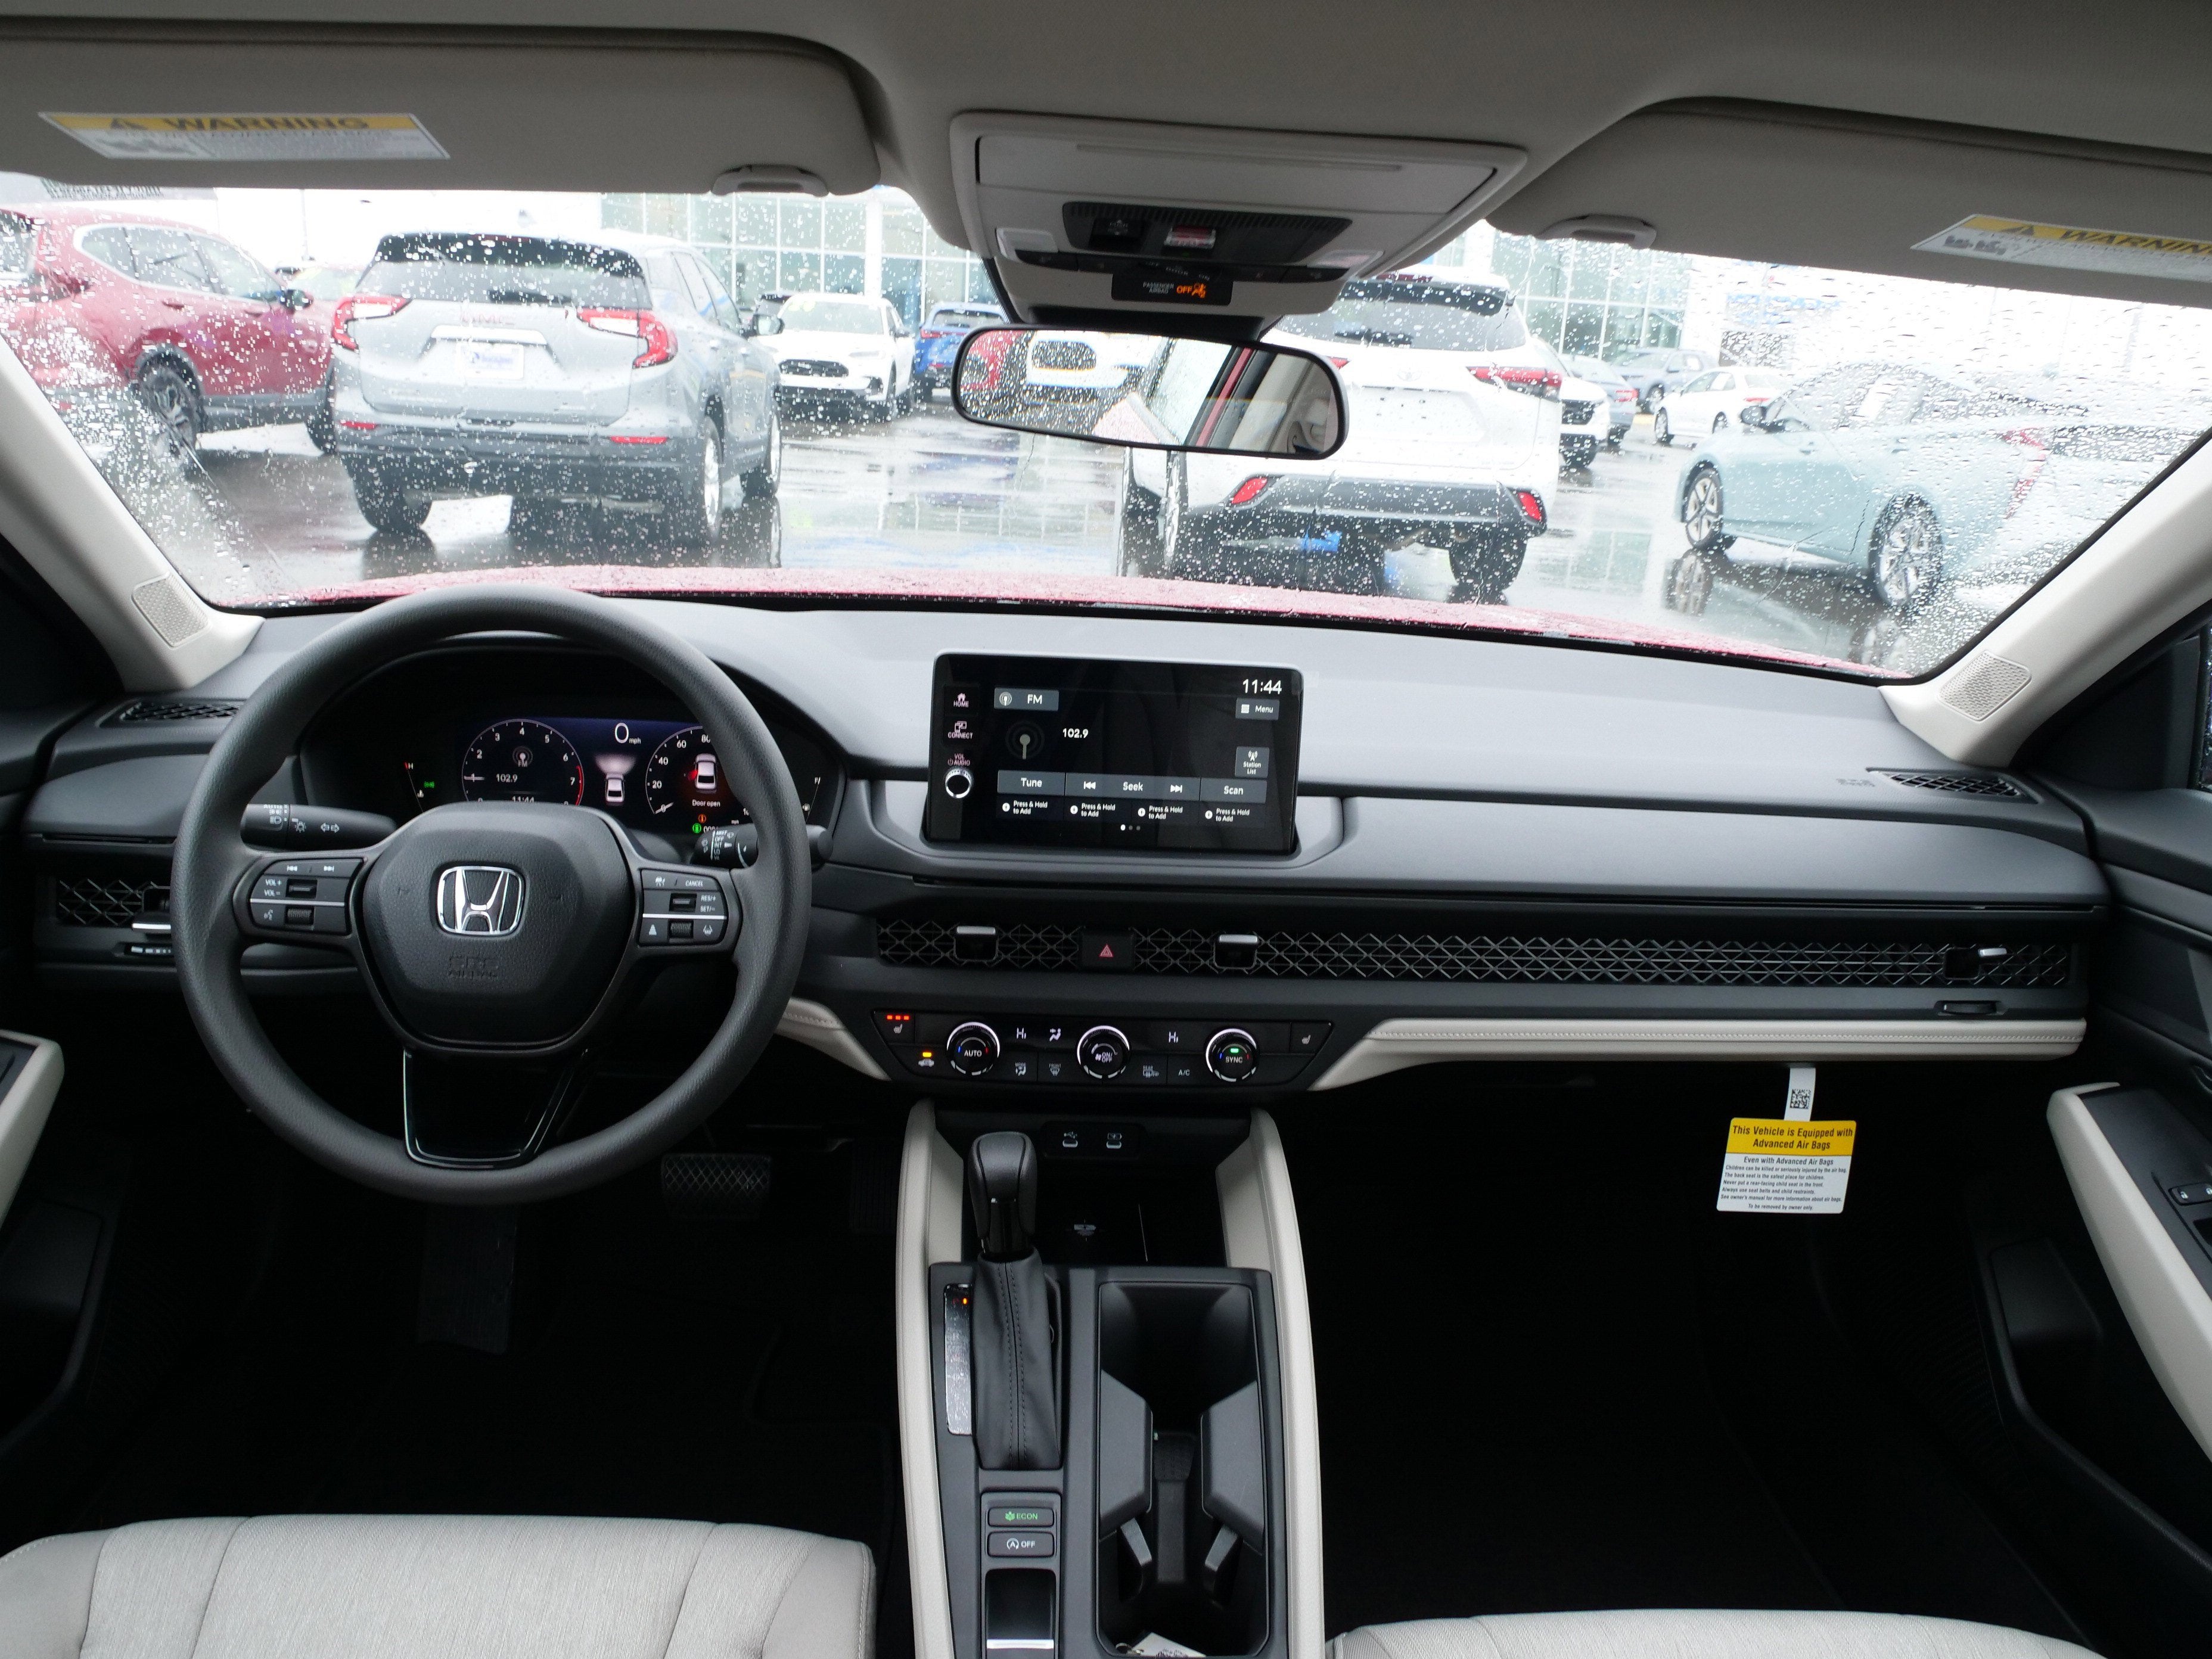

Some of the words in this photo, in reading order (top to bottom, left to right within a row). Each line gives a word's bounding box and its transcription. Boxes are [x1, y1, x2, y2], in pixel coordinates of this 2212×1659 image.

[161, 117, 370, 131] WARNING
[1176, 285, 1192, 294] OFF
[1242, 679, 1282, 695] 11:44
[1027, 694, 1043, 705] FM
[1255, 705, 1273, 713] Menu
[519, 726, 525, 736] 4
[614, 722, 629, 744] 0
[629, 737, 641, 745] mph
[1062, 728, 1089, 739] 102.9
[495, 732, 500, 741] 3
[544, 734, 550, 744] 5
[676, 740, 686, 748] 60
[476, 749, 483, 759] 2
[563, 753, 568, 762] 6
[658, 757, 669, 766] 40
[496, 773, 518, 783] 102.9
[570, 777, 576, 786] 7
[1021, 777, 1042, 788] Tune
[652, 780, 662, 789] 20
[1123, 781, 1144, 792] Seek
[1223, 785, 1244, 796] Scan
[964, 1049, 982, 1058] AUTO
[1733, 1125, 1750, 1135] This
[1753, 1126, 1785, 1136] Vehicle
[1787, 1127, 1795, 1136] is
[1797, 1127, 1835, 1139] Equipped
[1837, 1128, 1853, 1137] with
[1753, 1139, 1794, 1148] Advanced
[1797, 1140, 1810, 1150] Air
[1812, 1141, 1831, 1151] Bags
[1021, 1540, 1036, 1548] OFF
